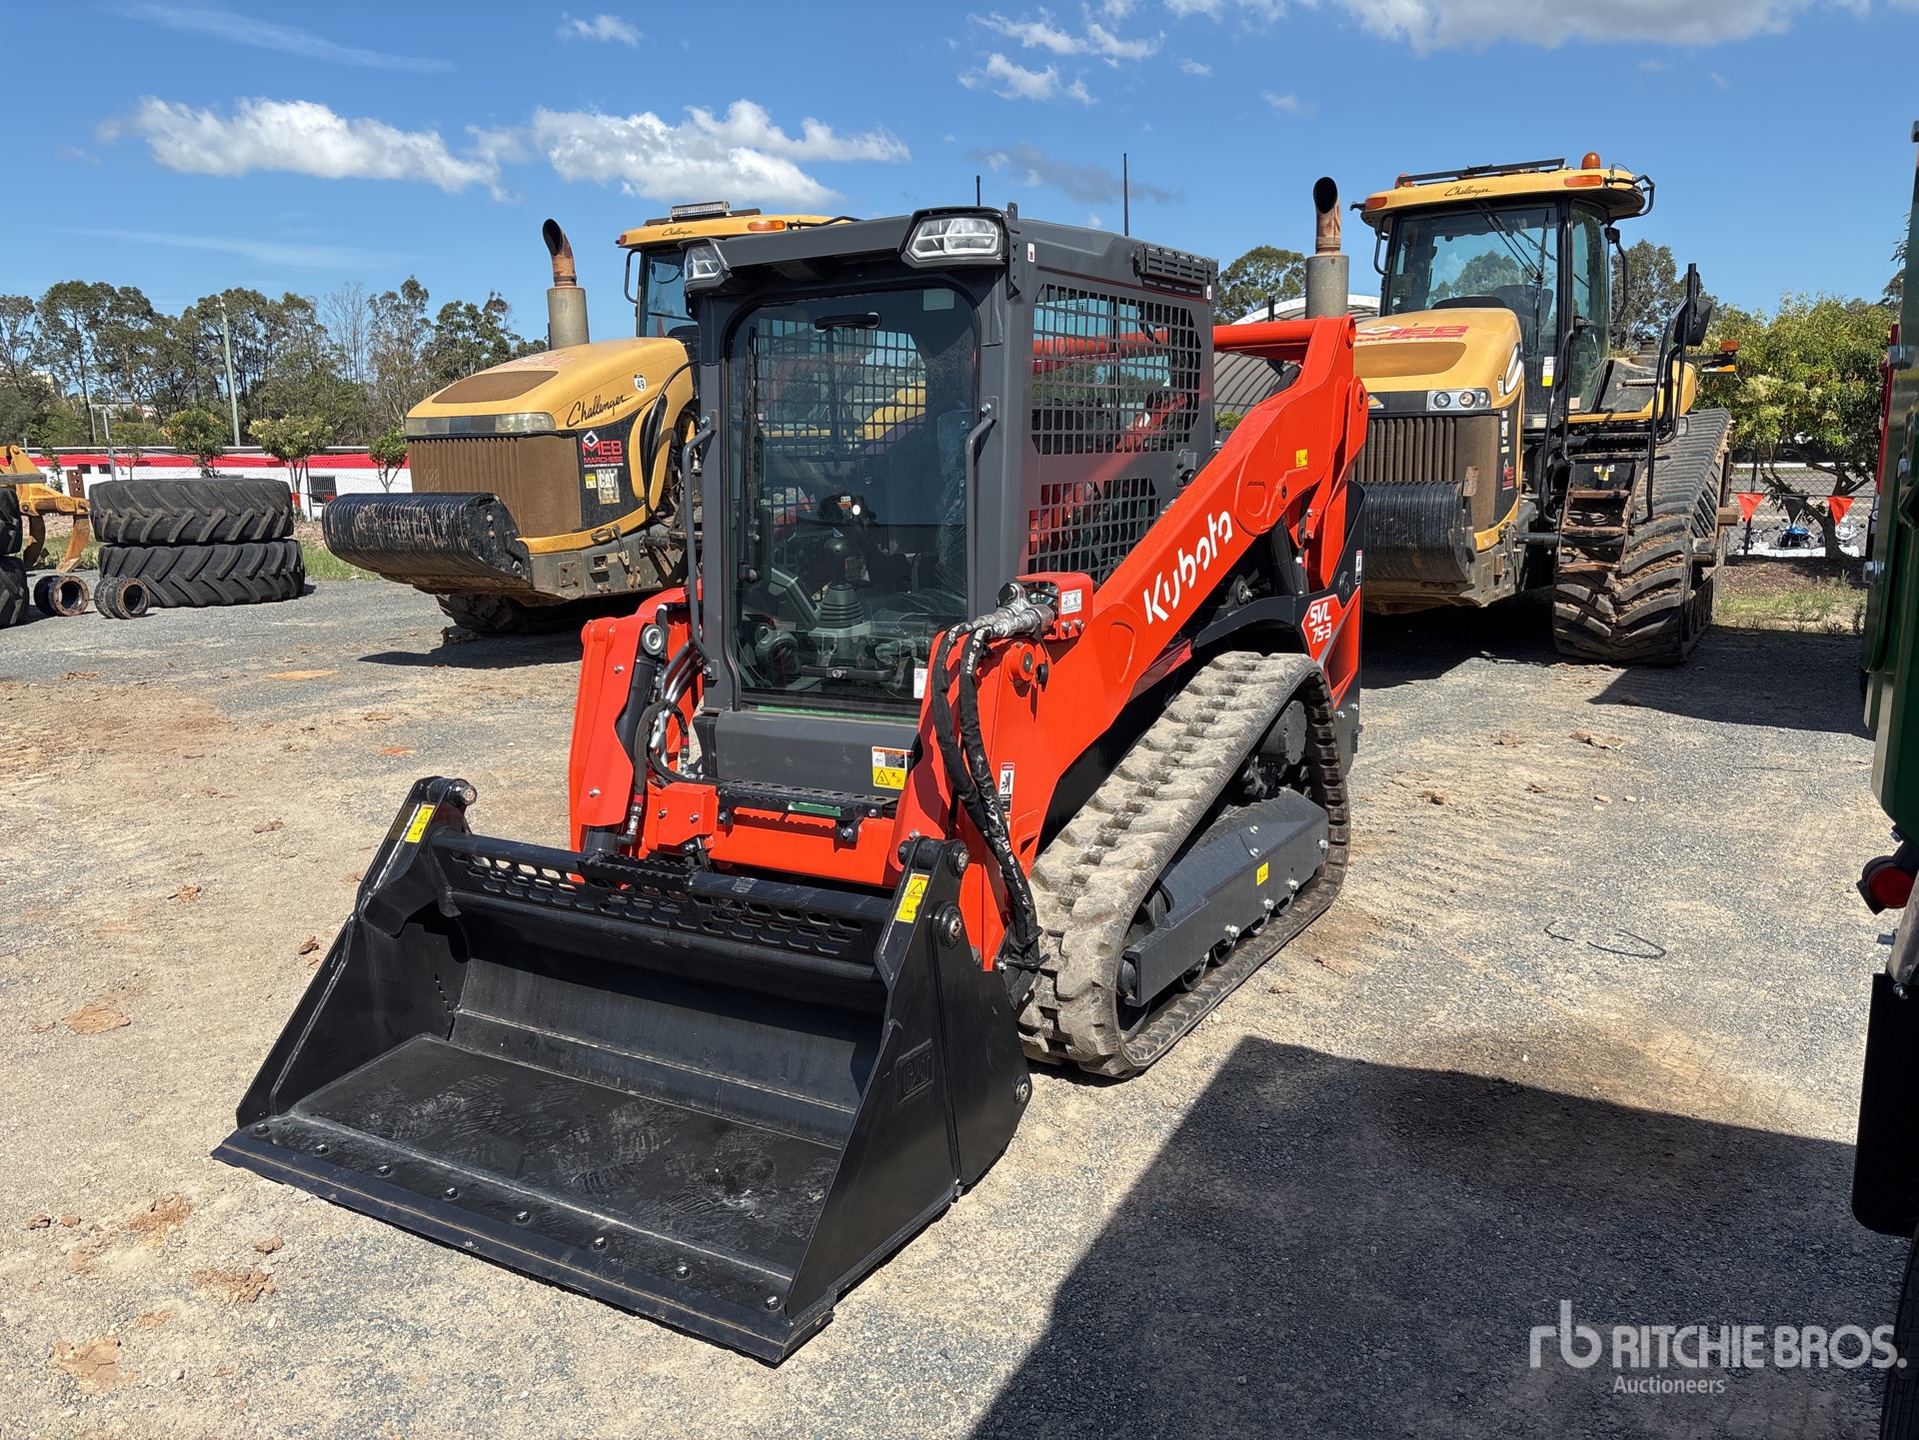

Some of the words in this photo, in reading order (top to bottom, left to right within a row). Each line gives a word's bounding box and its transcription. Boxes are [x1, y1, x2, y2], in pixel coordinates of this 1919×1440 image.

[1443, 185, 1496, 197] Challenger
[566, 394, 635, 428] Challenger
[582, 440, 623, 456] MEB
[1143, 510, 1233, 625] Kubota
[1308, 601, 1332, 628] SVL
[1312, 622, 1332, 644] 75-3
